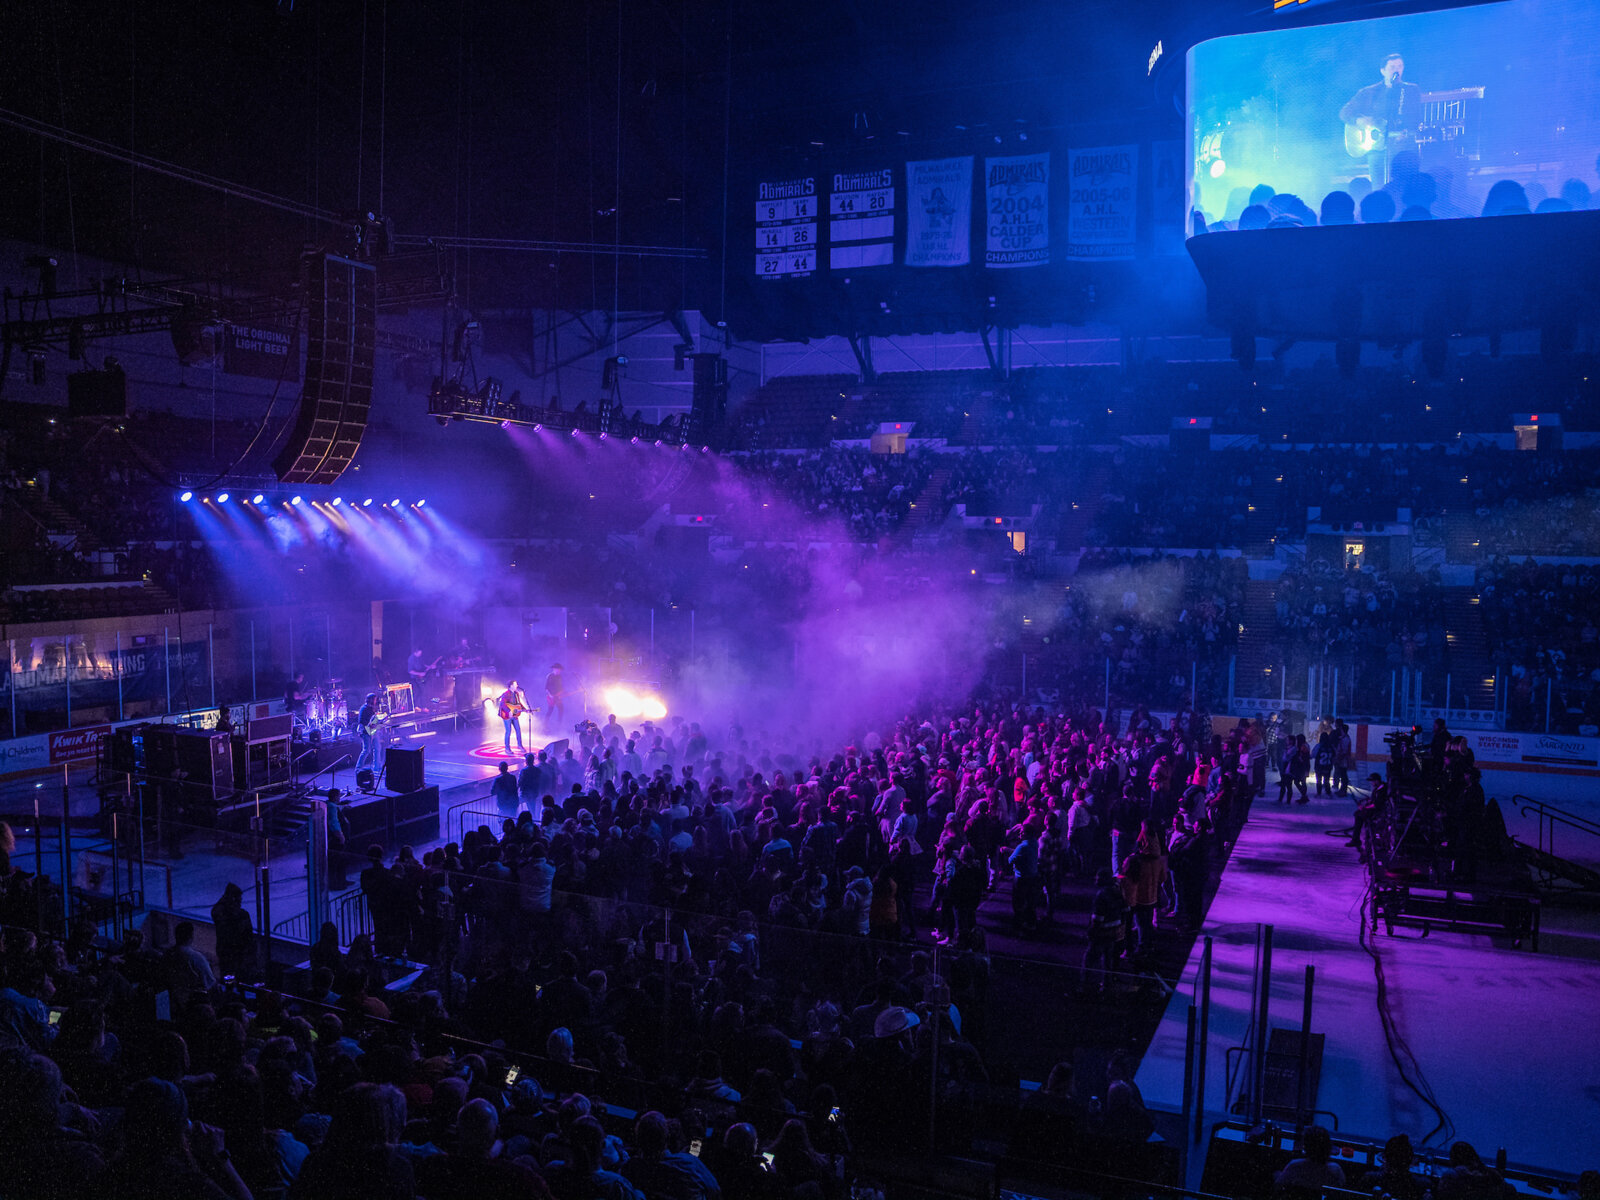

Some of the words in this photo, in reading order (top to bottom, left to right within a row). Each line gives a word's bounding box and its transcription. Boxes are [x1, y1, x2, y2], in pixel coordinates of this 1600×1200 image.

[834, 169, 891, 191] ADMIRALS
[989, 160, 1046, 188] ADMIRALS
[760, 177, 814, 199] ADMIRALS
[839, 199, 854, 212] 44
[870, 196, 885, 209] 20
[990, 194, 1044, 214] 2004
[768, 207, 776, 219] 9
[795, 204, 807, 216] 14
[793, 230, 808, 243] 26
[990, 224, 1045, 238] CALDER
[766, 233, 778, 246] 14
[1000, 237, 1032, 249] CUP
[985, 248, 1049, 262] CHAMPIONS
[764, 261, 778, 273] 27
[793, 258, 808, 270] 44
[231, 325, 249, 338] THE
[250, 328, 291, 345] ORIGINAL
[235, 337, 263, 352] LIGHT
[264, 343, 289, 356] BEER
[1478, 735, 1519, 744] WISCONSIN
